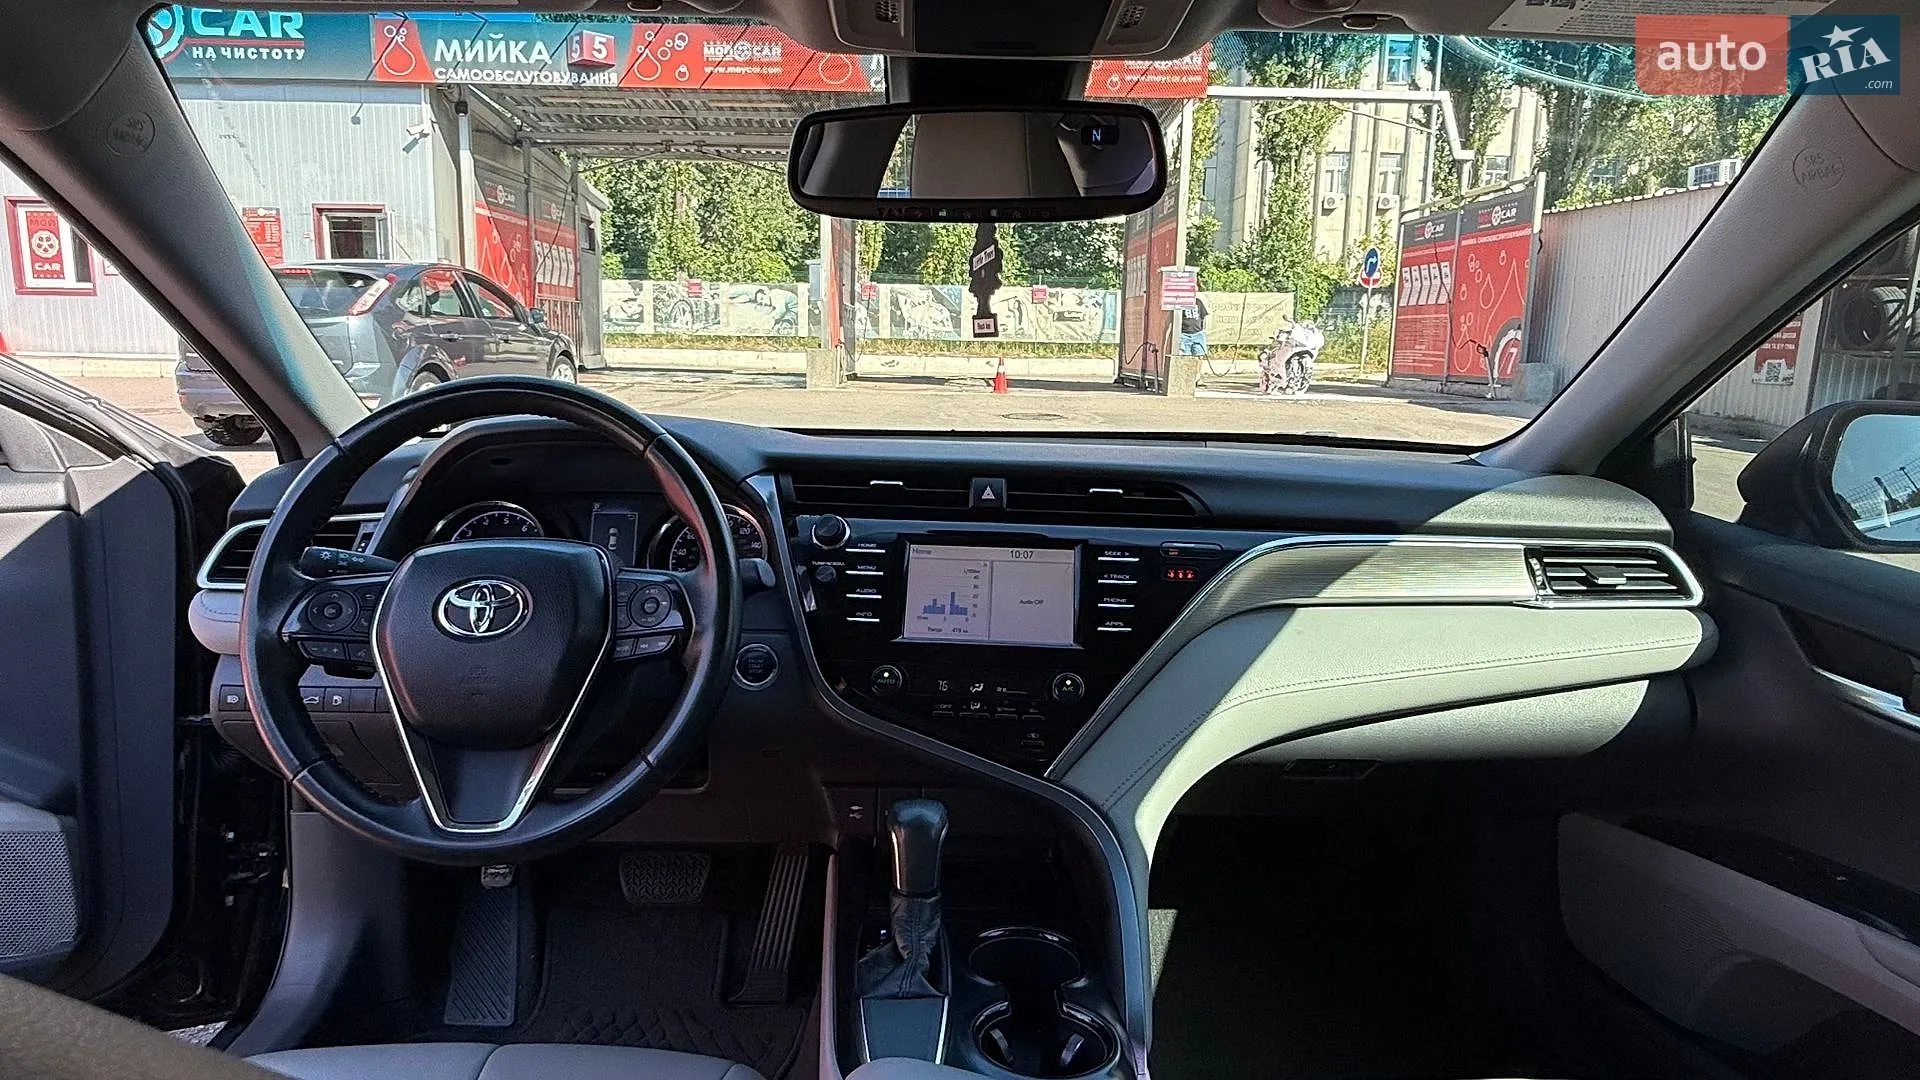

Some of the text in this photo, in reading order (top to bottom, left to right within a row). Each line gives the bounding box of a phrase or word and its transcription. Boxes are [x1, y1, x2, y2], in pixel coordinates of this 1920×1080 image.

[192, 8, 304, 38] CAR
[192, 46, 305, 61] НА ЧИСТОТУ
[434, 33, 553, 64] МИЙКА
[434, 67, 618, 85] САМООБСЛУГОВУВАННЯ
[1092, 128, 1101, 142] N
[34, 262, 61, 272] CAR
[502, 517, 510, 525] 5
[1009, 550, 1035, 560] 10:07
